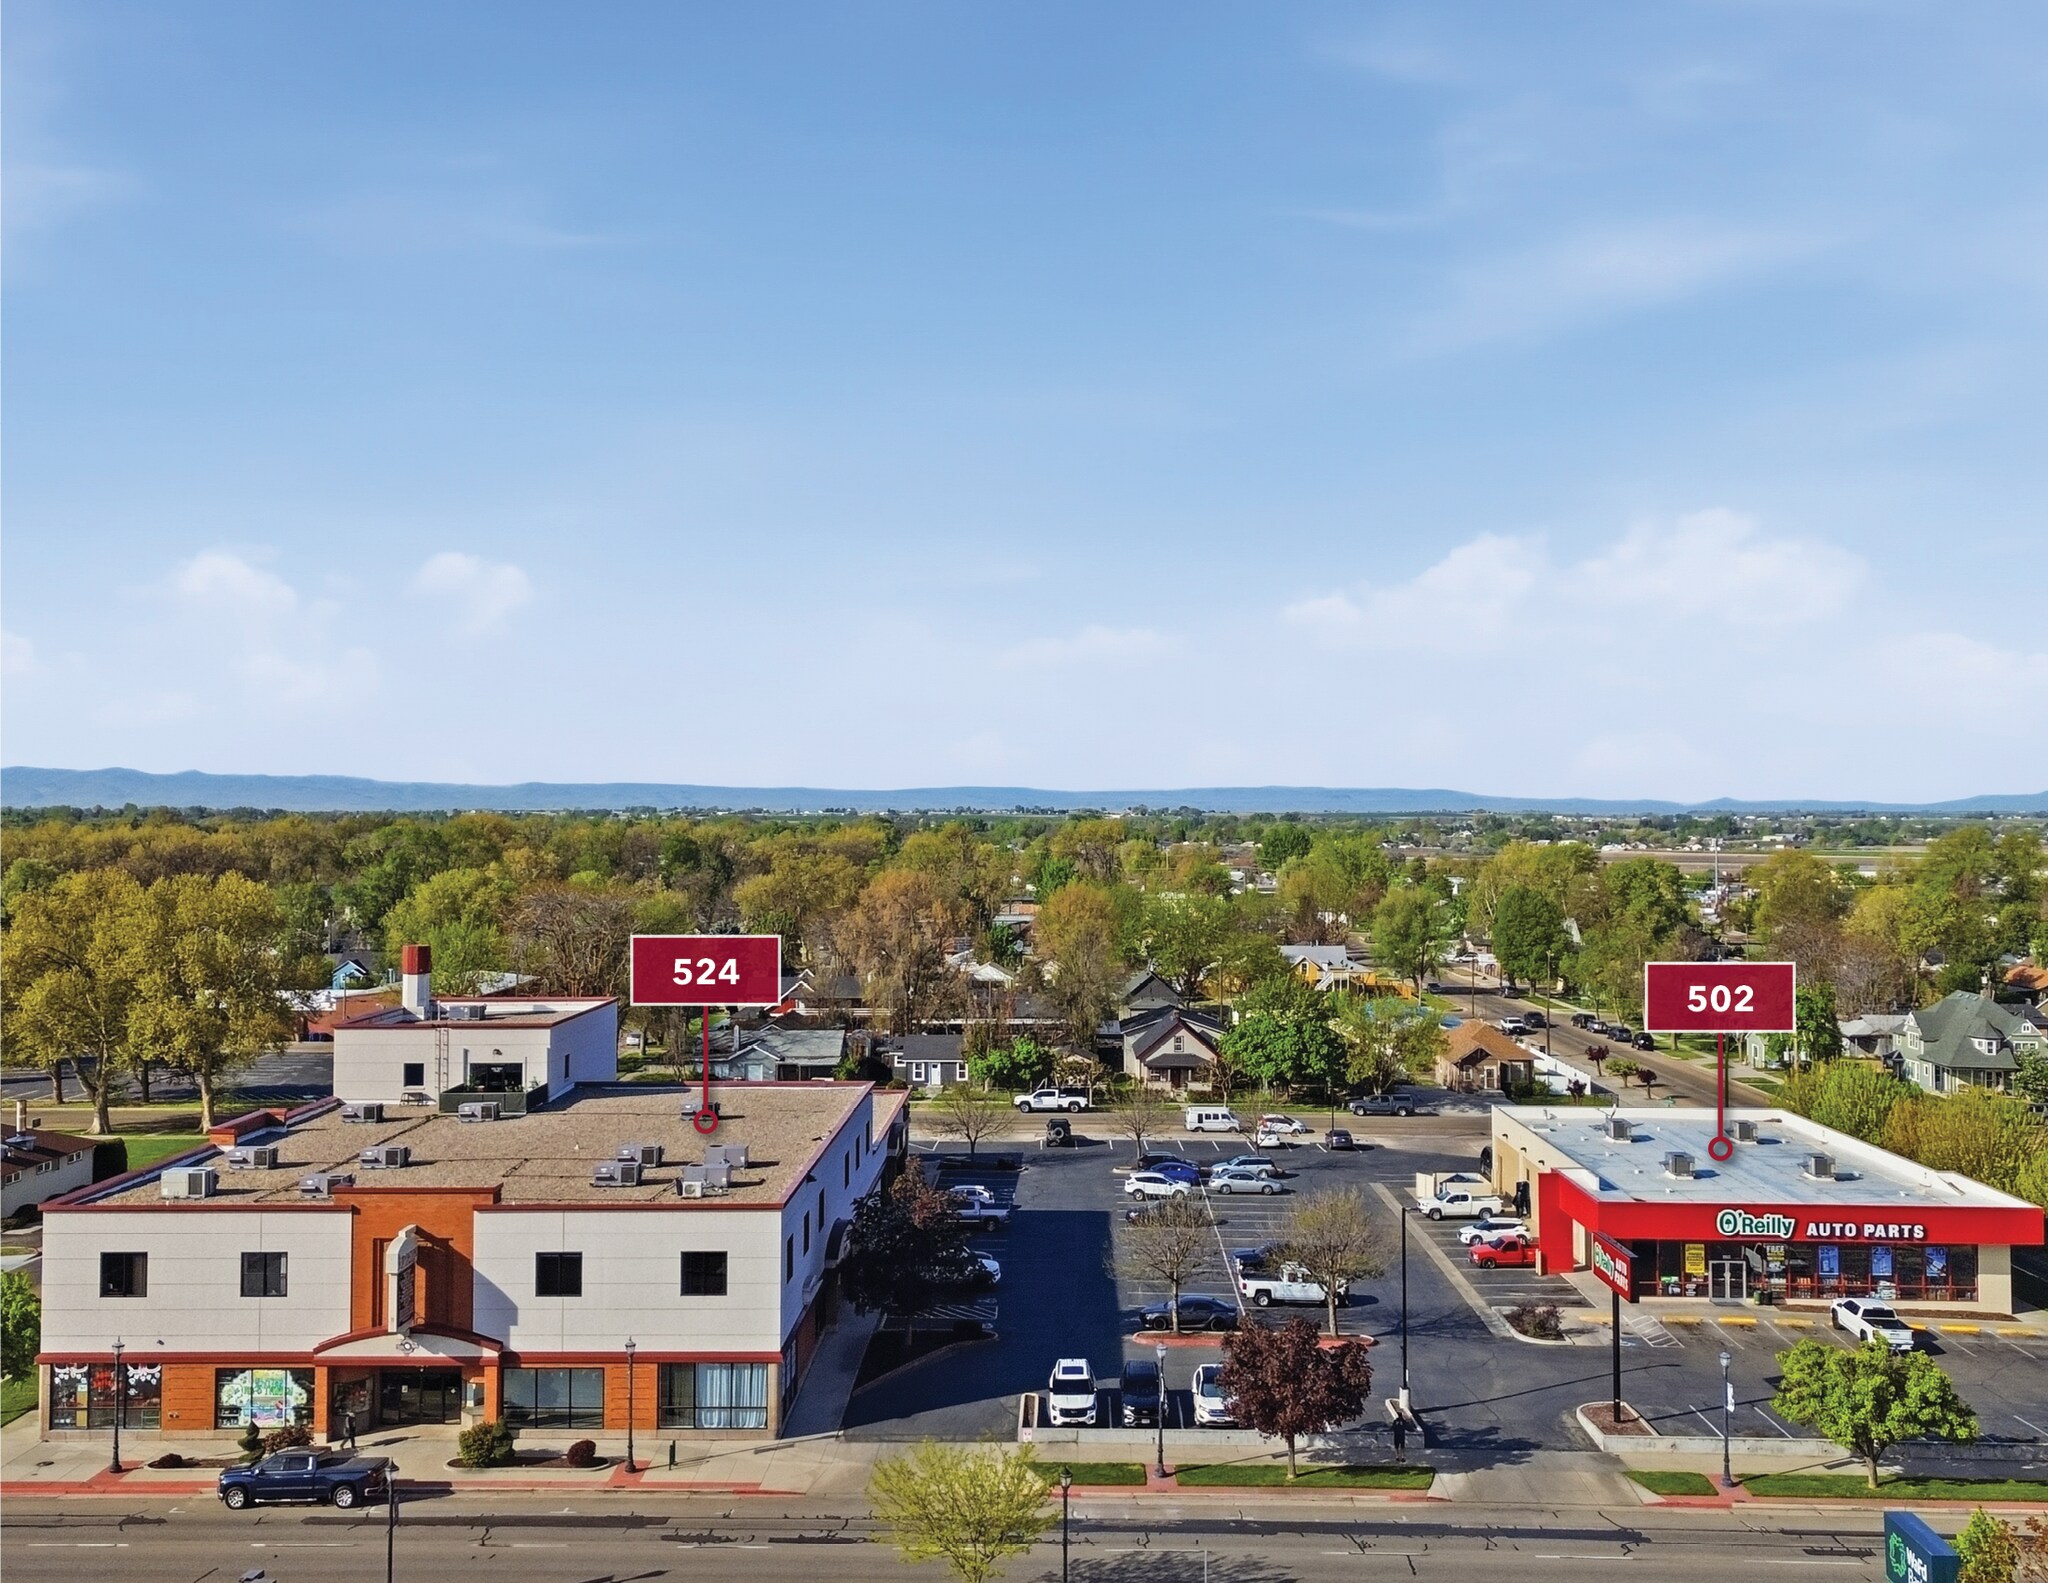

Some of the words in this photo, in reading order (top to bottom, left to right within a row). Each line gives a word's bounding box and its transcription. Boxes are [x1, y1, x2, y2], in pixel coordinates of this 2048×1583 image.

[1718, 1210, 1795, 1238] O'Reilly
[1806, 1223, 1857, 1237] AUTO
[1864, 1224, 1925, 1239] PARTS
[1906, 1546, 1928, 1582] WaFd
